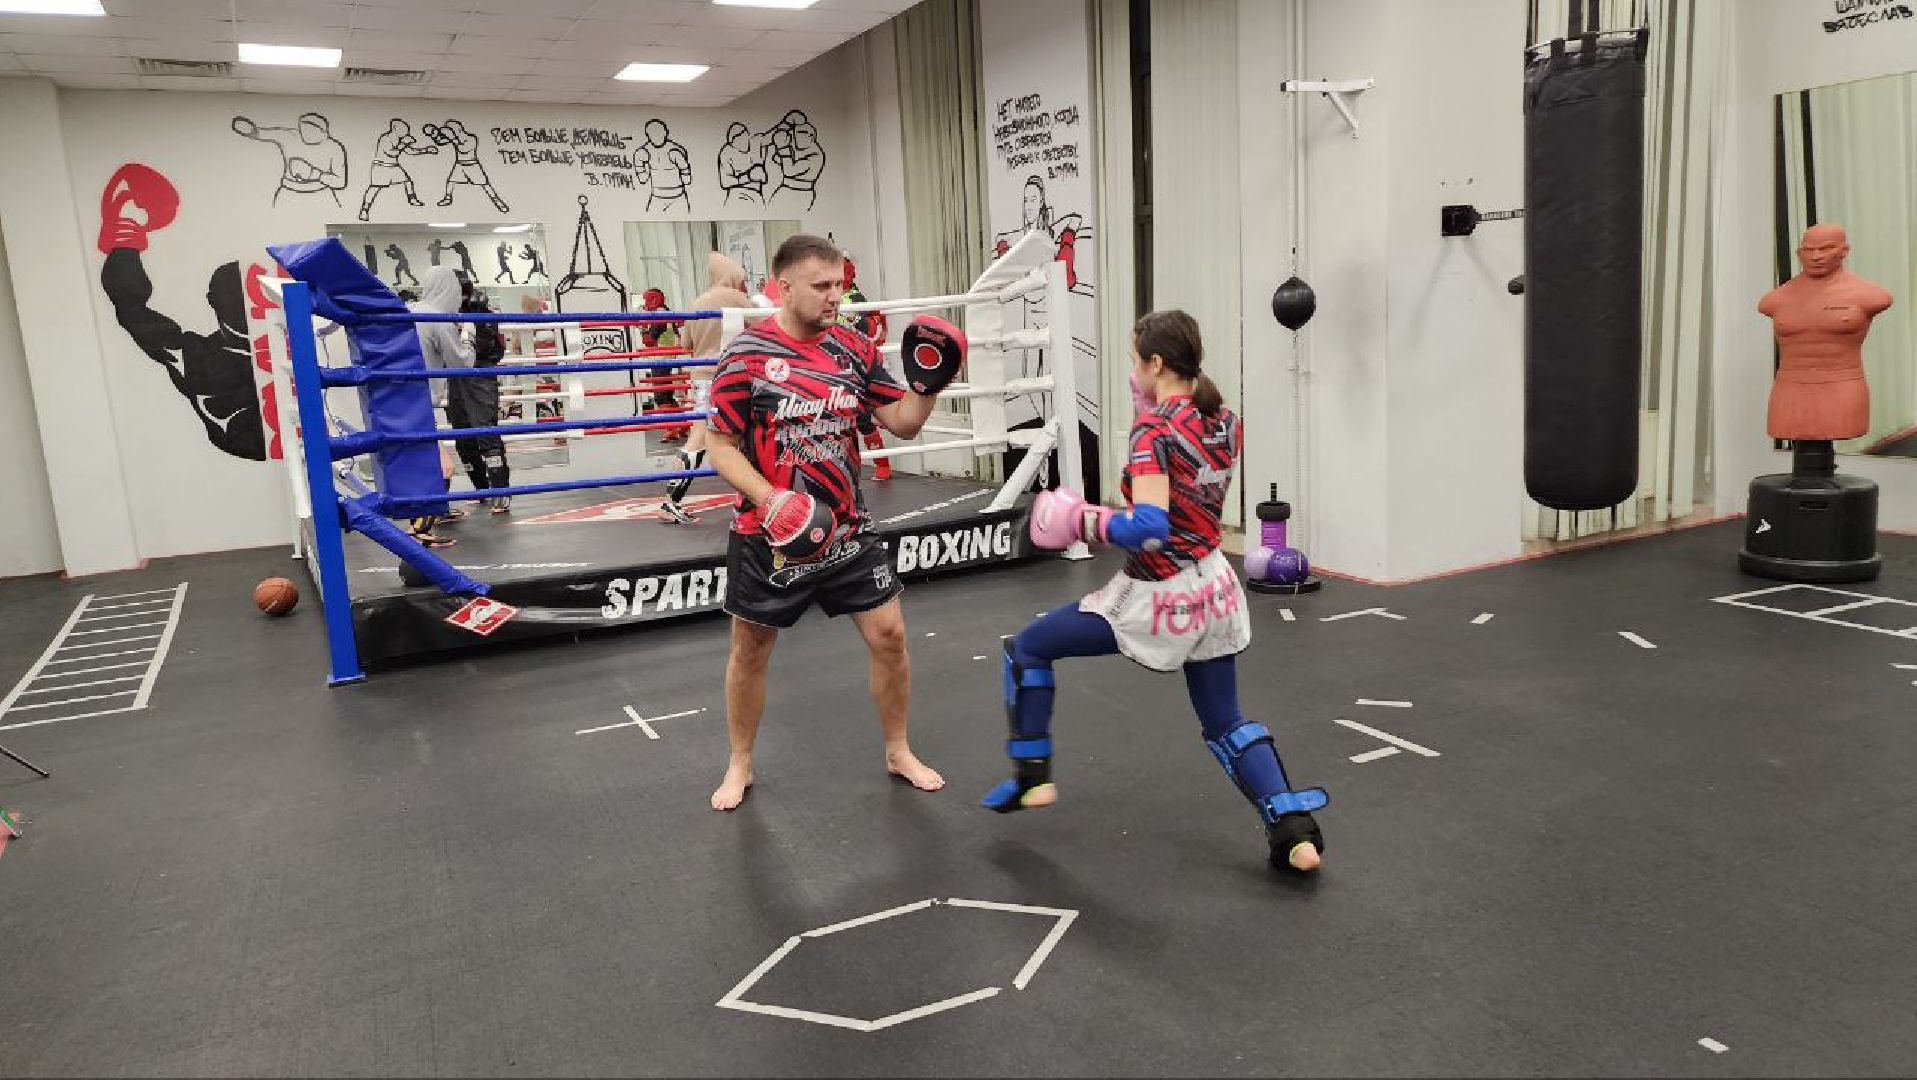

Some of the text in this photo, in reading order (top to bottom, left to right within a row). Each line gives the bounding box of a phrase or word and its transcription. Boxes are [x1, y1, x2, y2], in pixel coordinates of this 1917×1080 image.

[491, 127, 522, 145] ЧЕМ
[584, 334, 622, 350] OXING
[897, 521, 1011, 573] BOXING
